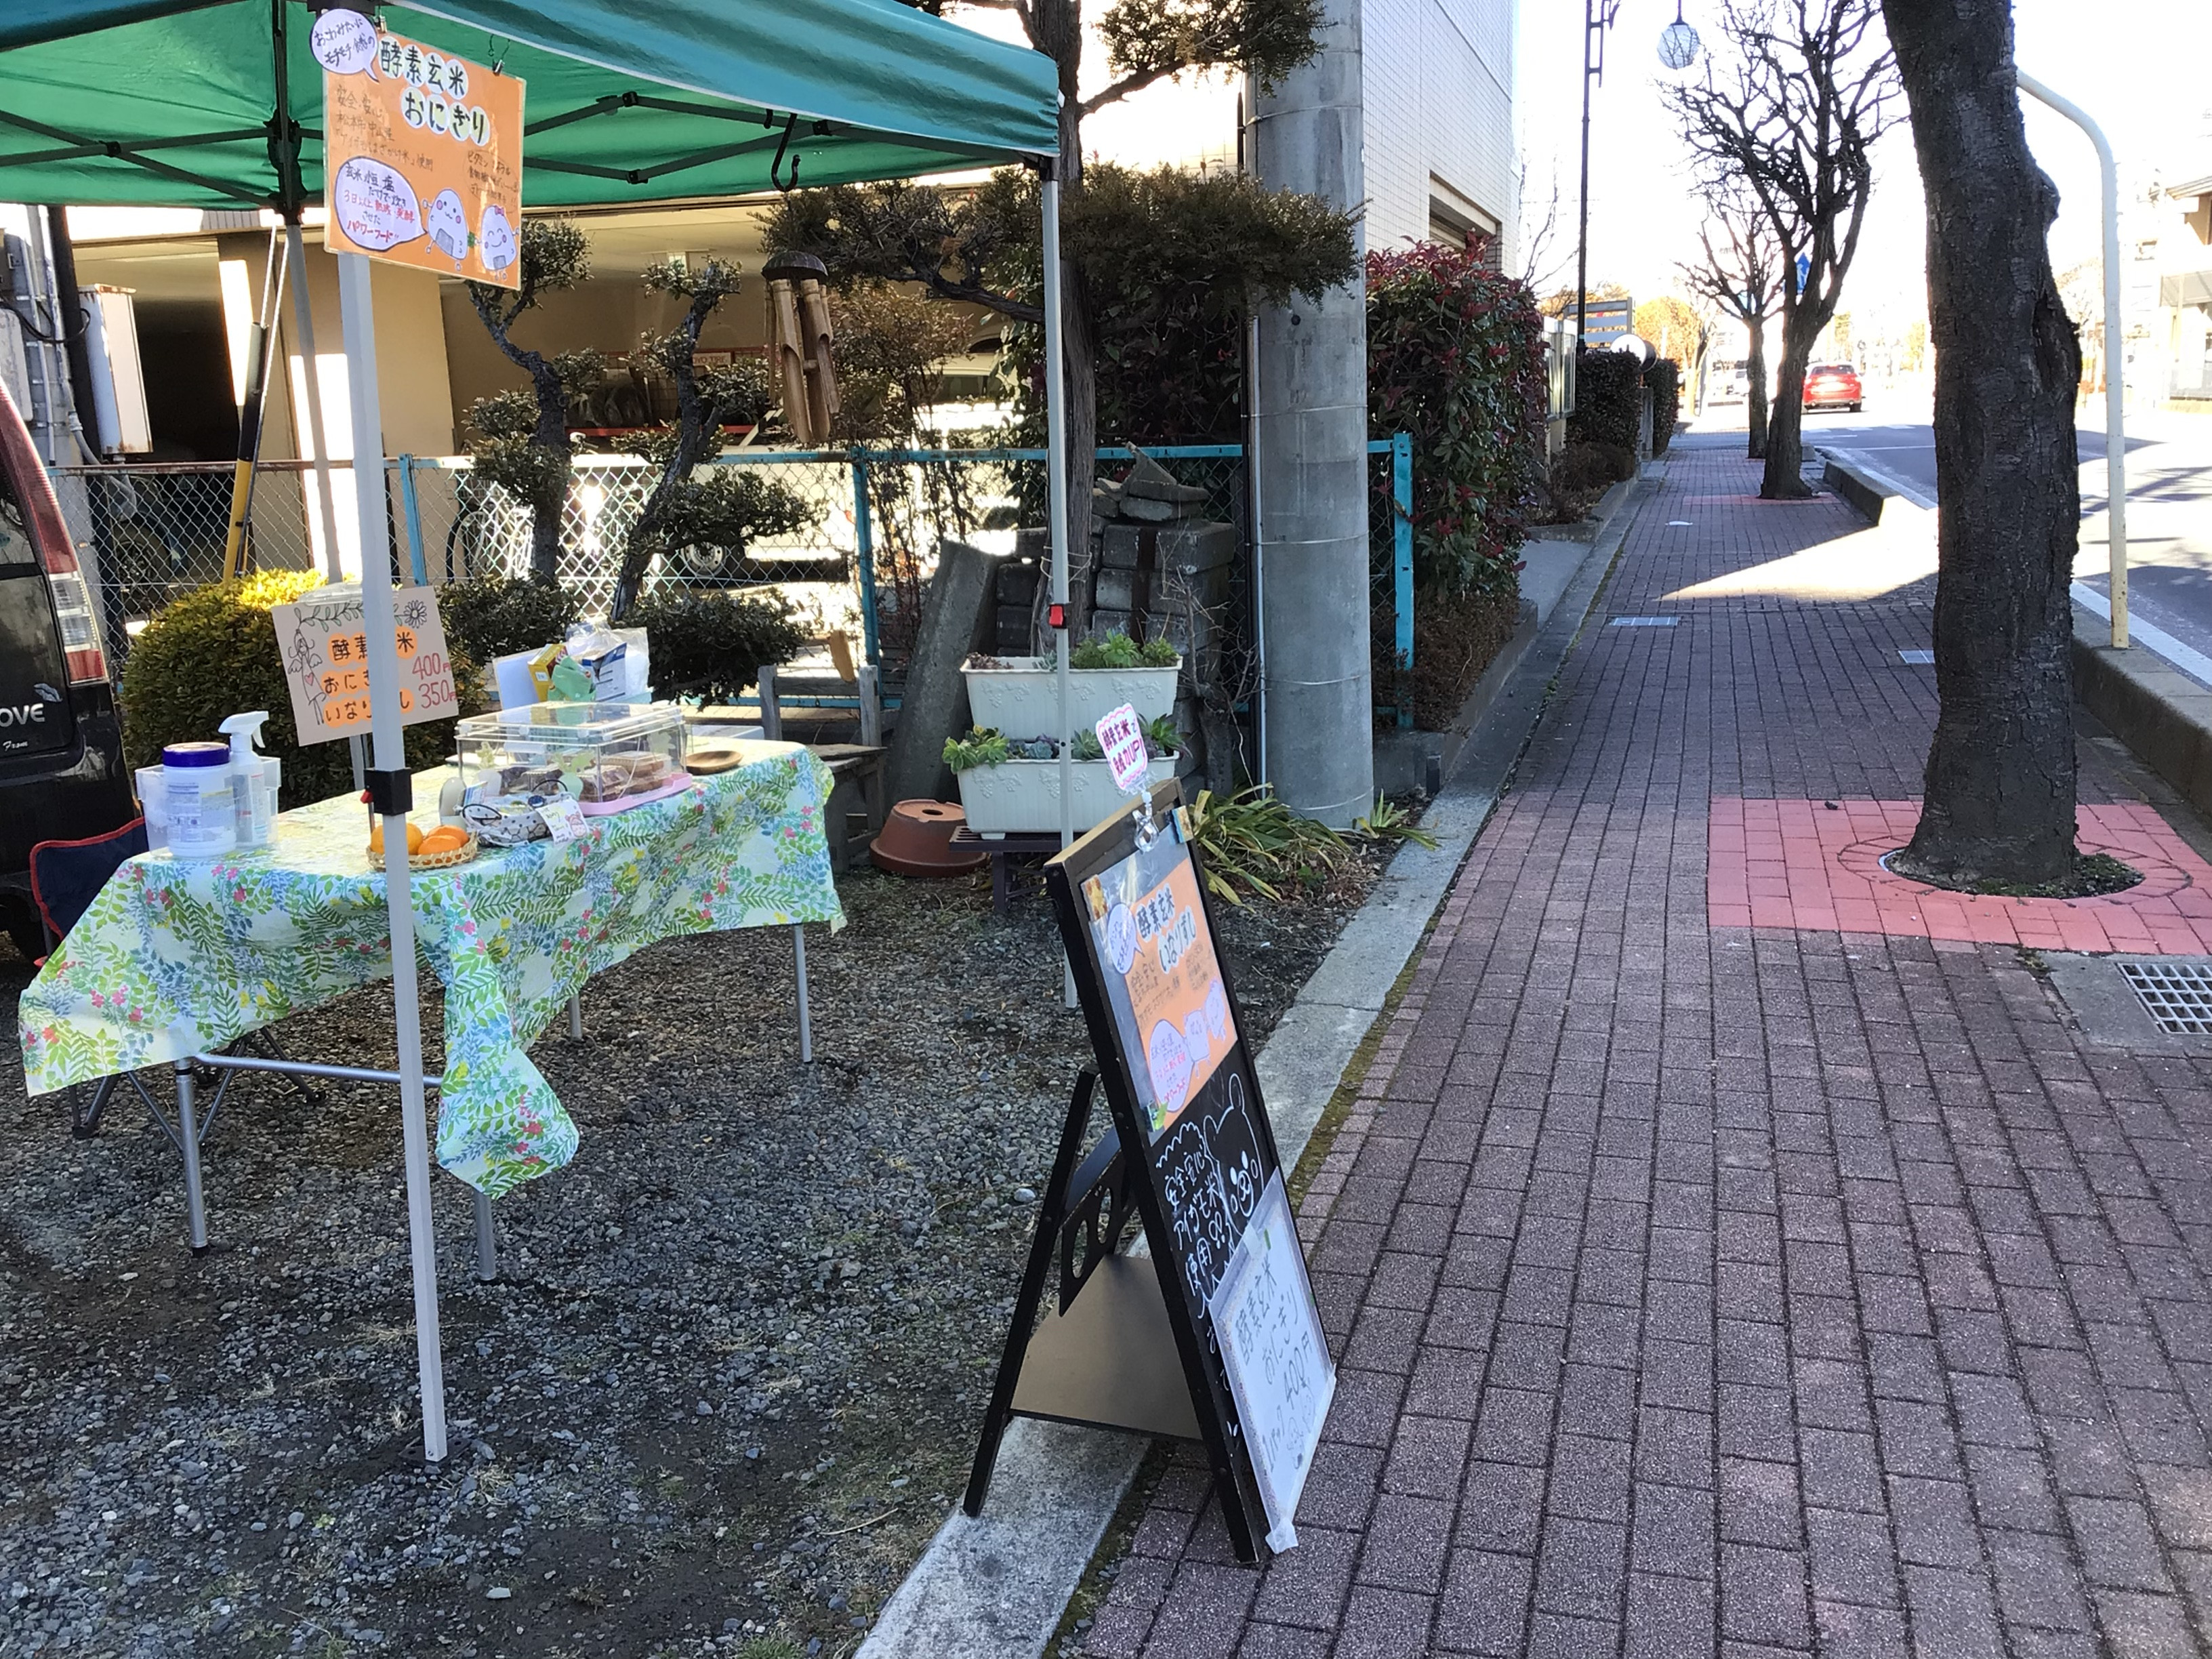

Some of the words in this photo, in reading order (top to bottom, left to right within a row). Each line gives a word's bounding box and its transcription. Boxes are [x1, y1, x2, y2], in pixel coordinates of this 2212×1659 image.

[381, 40, 465, 96] 酵素玄米
[405, 91, 485, 144] おにぎり
[1138, 886, 1174, 939] 酵素玄米
[1160, 911, 1196, 972] いなりずし
[1173, 1173, 1218, 1251] アイガモ米
[1236, 1254, 1277, 1366] 酵素玄米
[1263, 1284, 1298, 1385] おにぎり
[1284, 1330, 1313, 1410] 400円
